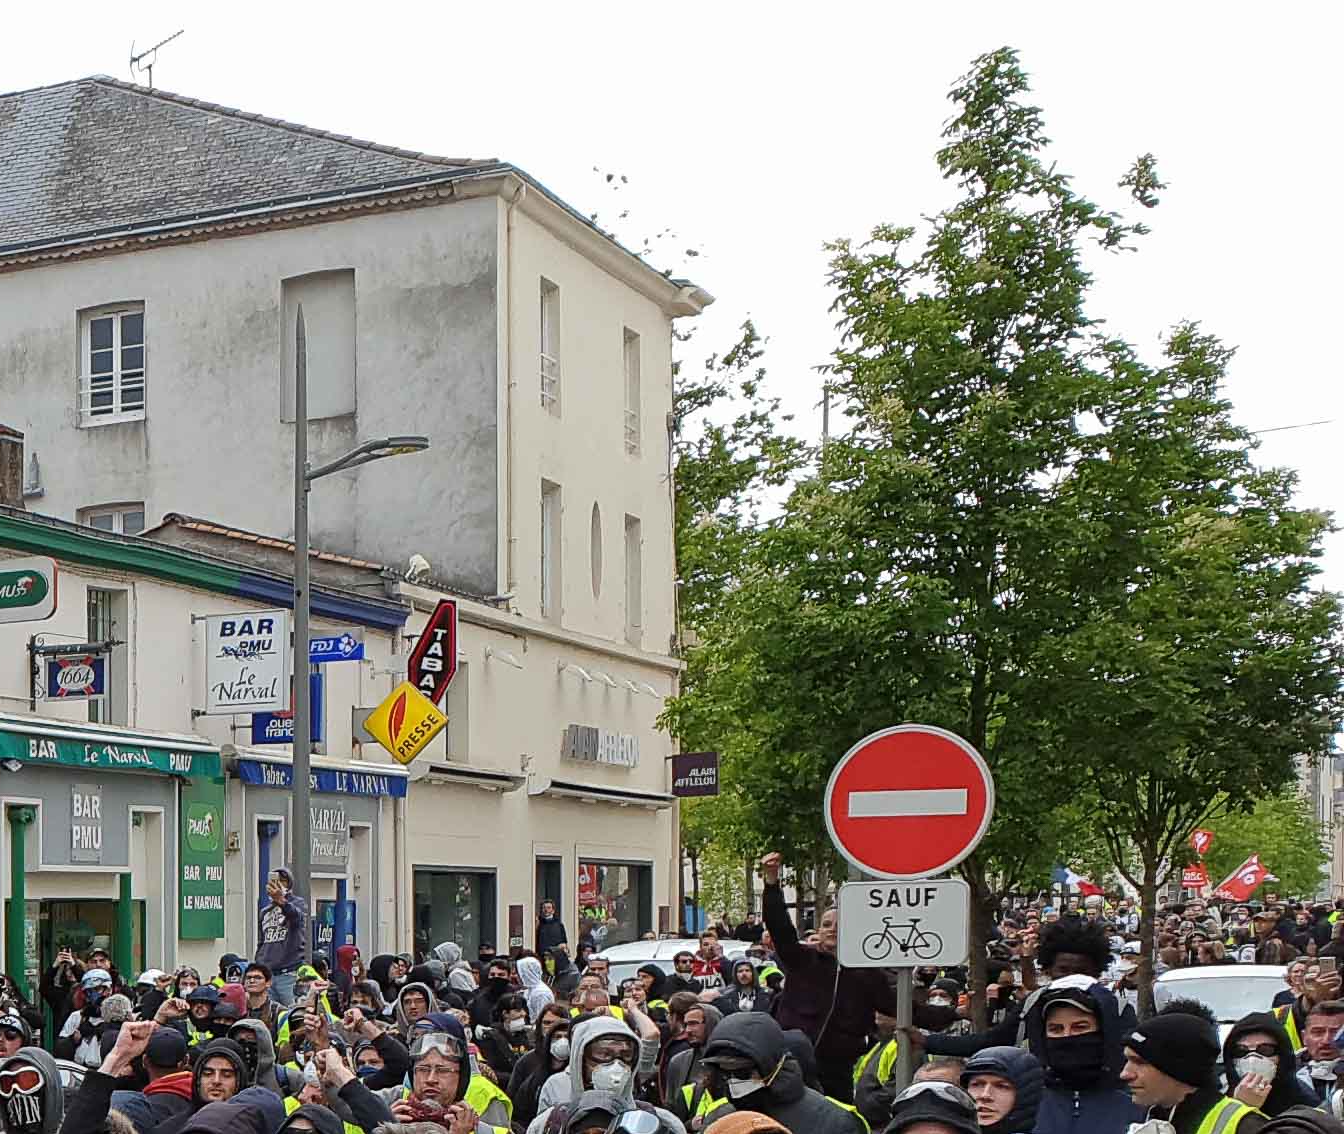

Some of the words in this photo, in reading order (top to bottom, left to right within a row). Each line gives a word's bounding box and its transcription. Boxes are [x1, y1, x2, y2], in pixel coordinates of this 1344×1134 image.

[219, 618, 274, 637] BAR
[239, 639, 273, 652] PMU
[310, 640, 334, 652] FDJ
[59, 668, 93, 686] 1664
[235, 666, 256, 686] Le
[212, 678, 278, 701] Narval
[398, 713, 439, 757] PRESSE
[28, 739, 58, 759] BAR
[83, 744, 100, 763] Le
[169, 753, 192, 772] PMU
[674, 776, 716, 787] AFFLELOU
[688, 767, 716, 777] ALAIN
[335, 771, 348, 792] LE
[351, 773, 390, 795] NARVAL
[73, 794, 101, 819] BAR
[72, 825, 102, 850] PMU
[183, 865, 201, 881] BAR
[205, 865, 223, 881] PMU
[183, 896, 193, 909] LE
[194, 896, 223, 910] NARVAL
[868, 886, 939, 911] SAUF
